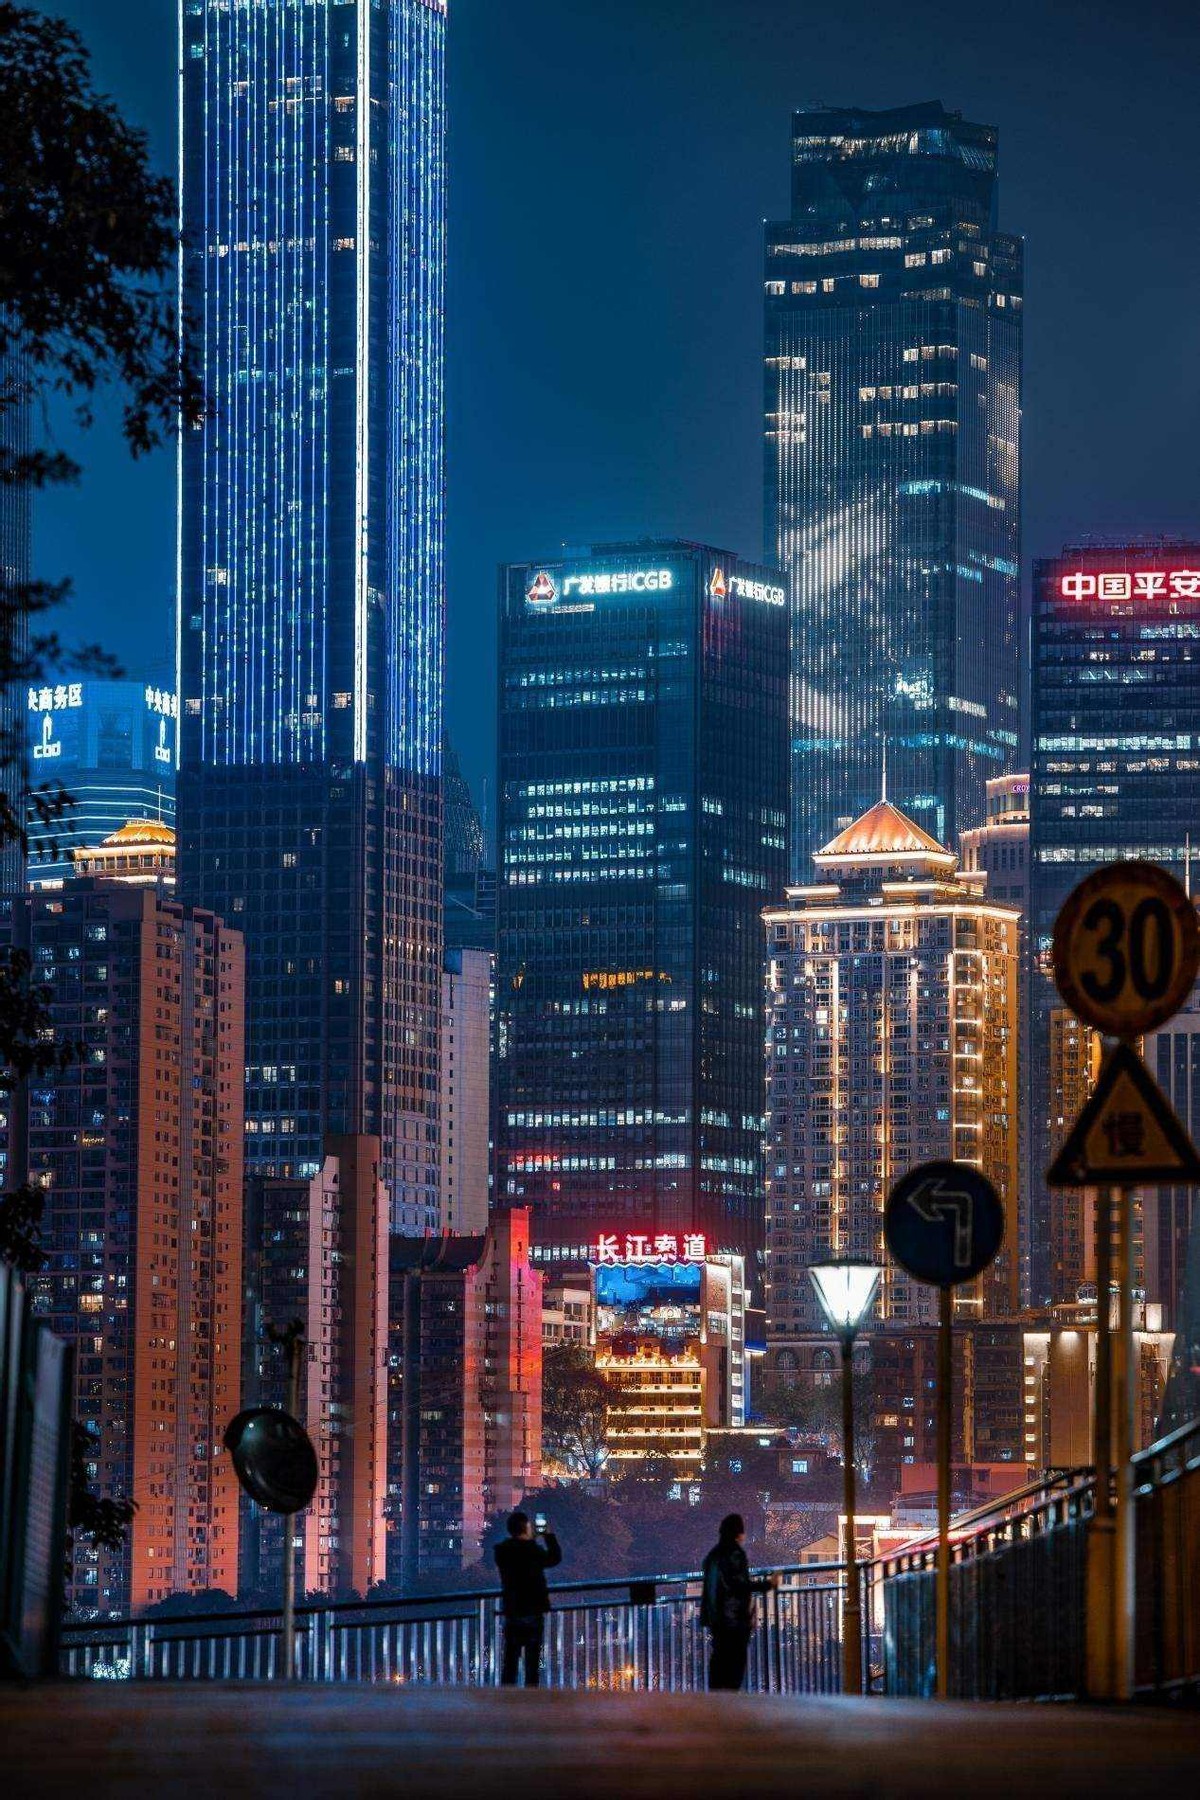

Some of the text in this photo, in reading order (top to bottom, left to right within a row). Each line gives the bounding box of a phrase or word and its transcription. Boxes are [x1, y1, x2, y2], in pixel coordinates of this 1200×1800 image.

[632, 571, 672, 591] CGB
[1061, 569, 1200, 600] 中国平安
[1081, 897, 1174, 1001] 30
[597, 1233, 706, 1262] 长江索道
